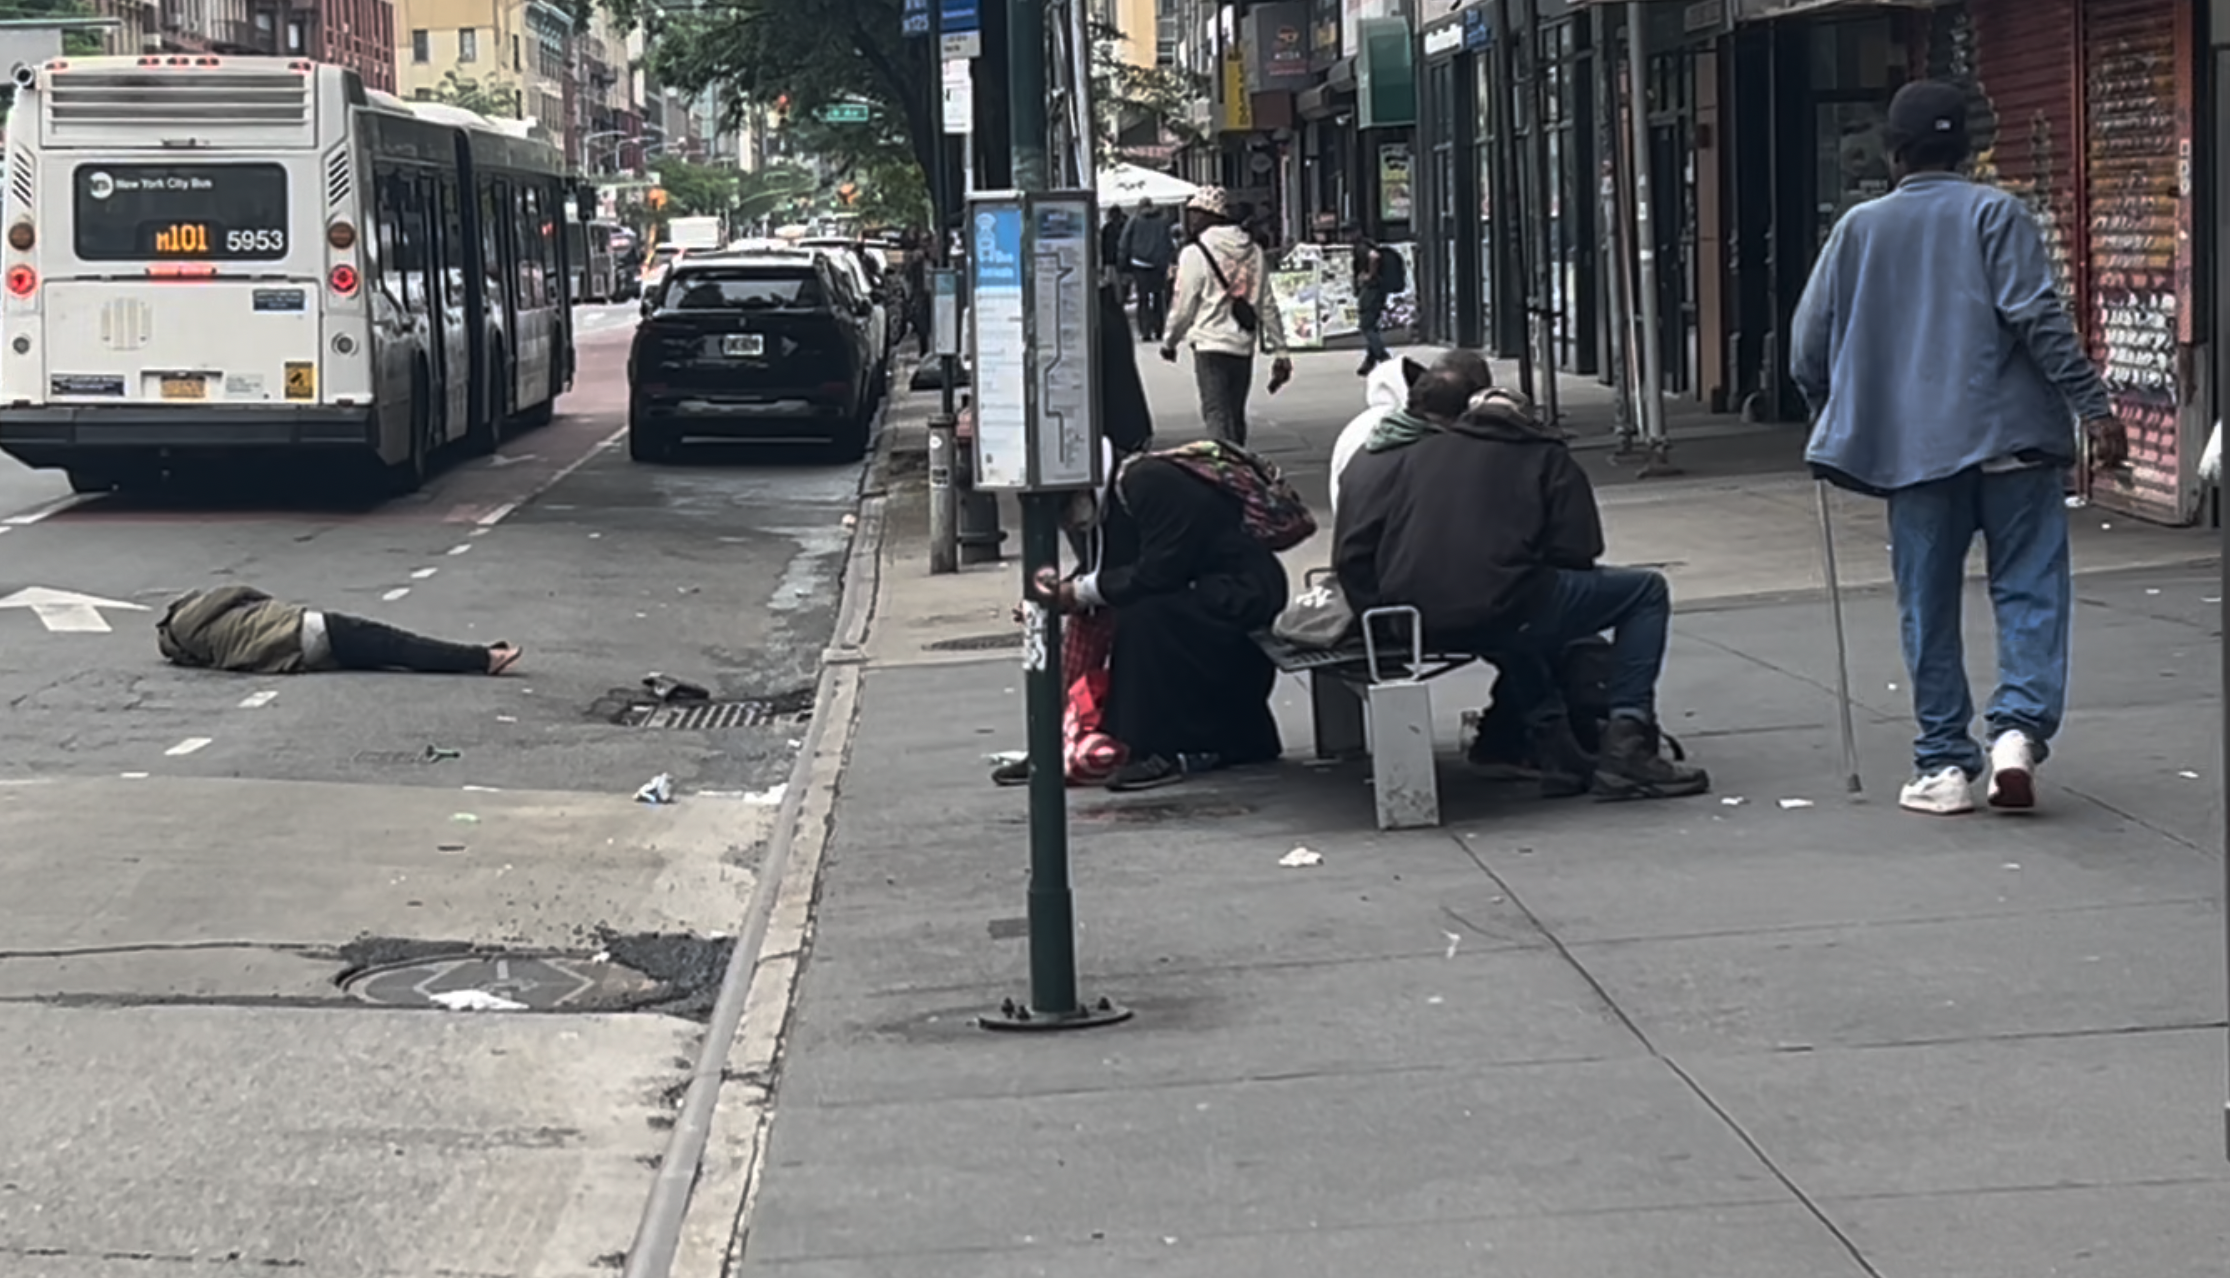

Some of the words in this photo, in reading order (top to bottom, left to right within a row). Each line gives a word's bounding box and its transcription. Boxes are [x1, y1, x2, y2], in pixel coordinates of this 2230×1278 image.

[115, 178, 139, 189] New
[141, 178, 165, 189] York
[167, 177, 189, 190] City
[191, 178, 213, 189] Bus
[156, 224, 208, 251] M101
[226, 230, 284, 251] 5953
